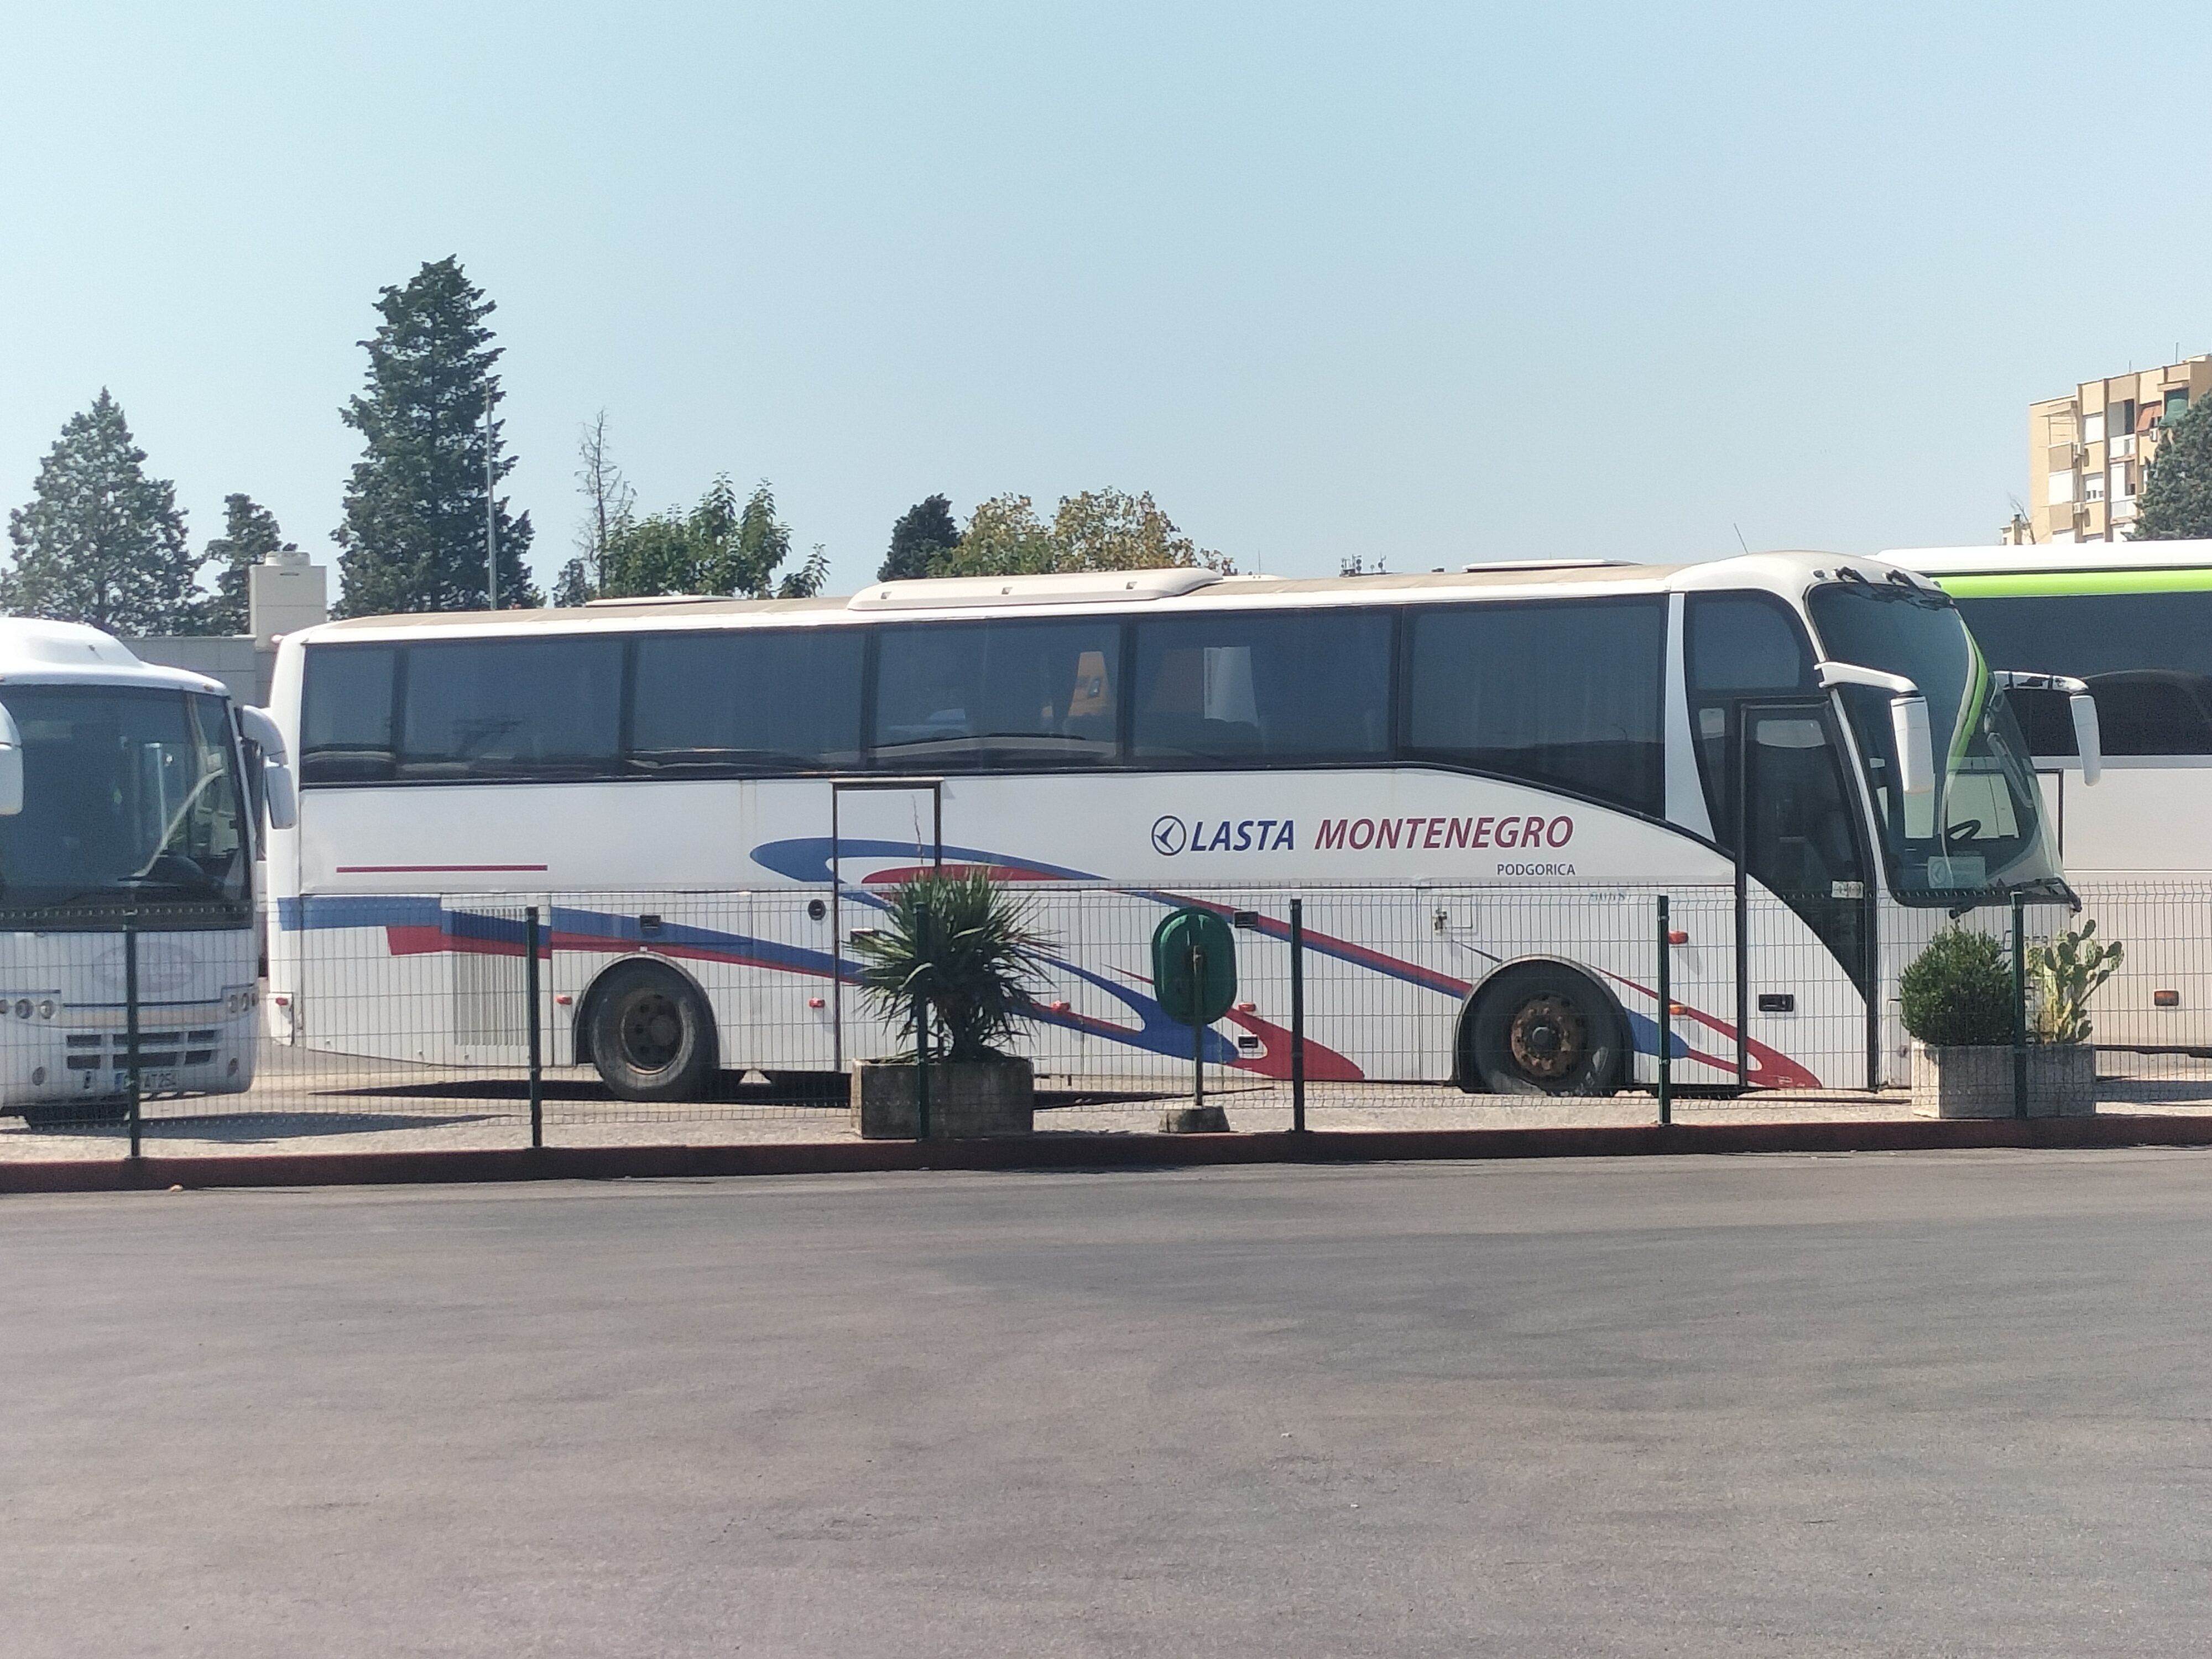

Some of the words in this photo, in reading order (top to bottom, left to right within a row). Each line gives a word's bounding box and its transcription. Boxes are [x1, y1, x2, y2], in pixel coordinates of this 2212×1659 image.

[1191, 820, 1295, 851] LASTA
[1314, 816, 1573, 850] MONTENEGRO
[1497, 863, 1575, 876] PODGORICA
